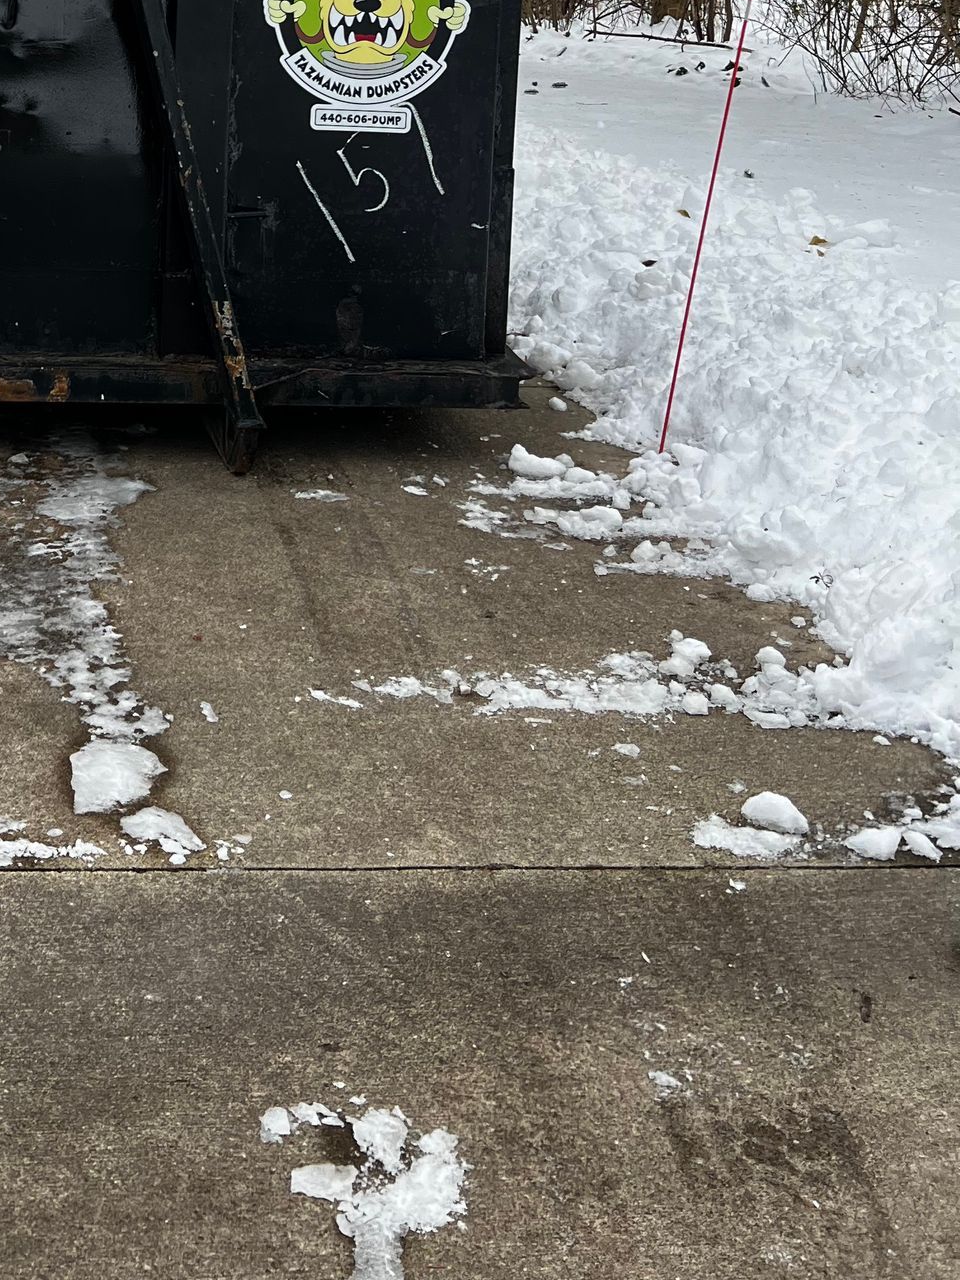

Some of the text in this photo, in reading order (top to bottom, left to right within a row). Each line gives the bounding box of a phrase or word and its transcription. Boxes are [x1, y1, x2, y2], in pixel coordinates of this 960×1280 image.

[294, 55, 433, 98] TAZMANIAN DUMPSTERS
[320, 113, 401, 126] 440-606-DUMP
